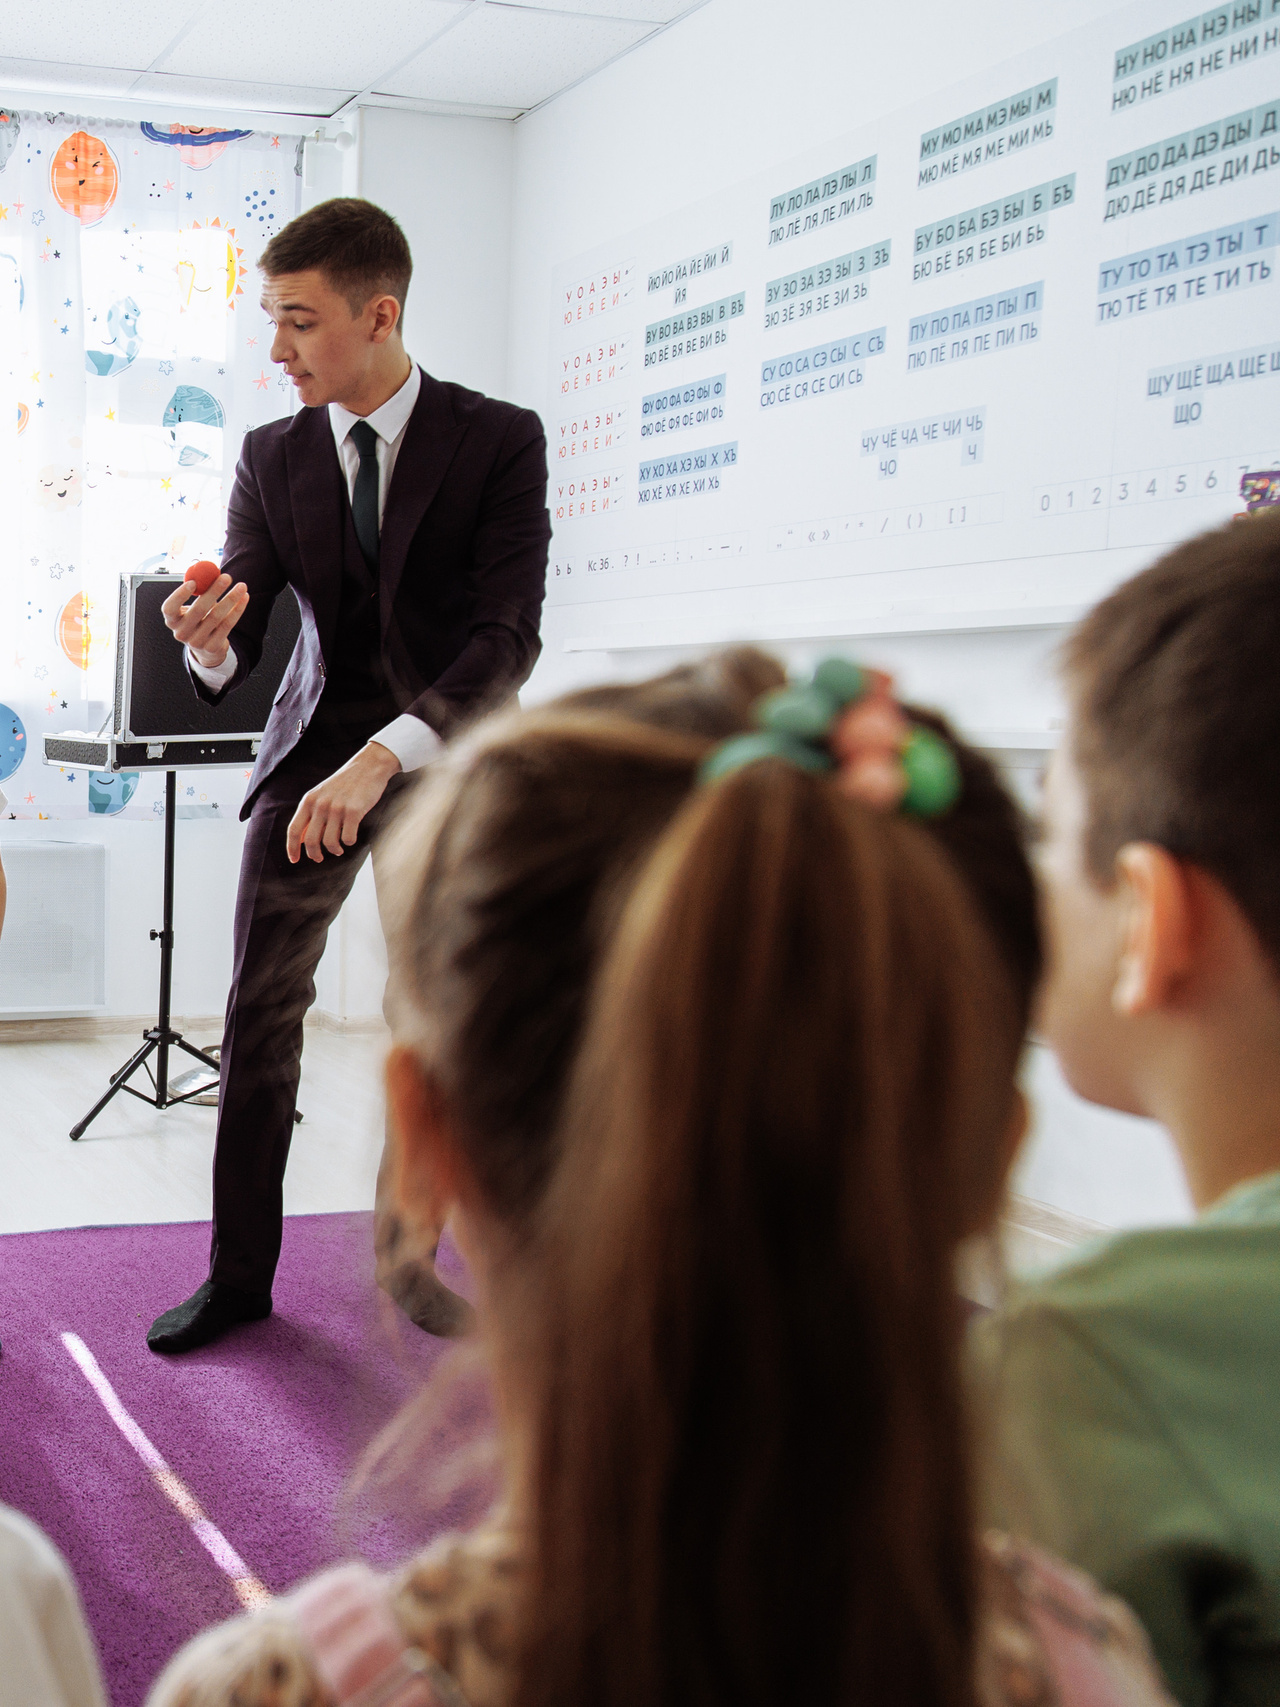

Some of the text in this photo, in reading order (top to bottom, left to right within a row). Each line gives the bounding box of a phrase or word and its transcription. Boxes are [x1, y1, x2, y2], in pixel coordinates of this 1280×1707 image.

[1116, 0, 1261, 77] НУ НО НА НЭ НЫ
[1112, 36, 1258, 111] НЮ НЁ НЯ НЕ НИ
[921, 89, 1051, 157] МУ МО МА МЭ МЫ М
[918, 120, 1053, 186] МЮ МЁ МЯ МЕ МИ МЬ
[1106, 111, 1276, 190] ДУ ДО ДА ДЭ ДЫ Д
[771, 164, 871, 219] ЛУ ЛО ЛА ЛЭ ЛЫ Л
[1104, 195, 1129, 222] ДЮ
[1132, 182, 1156, 212] ДЁ
[1160, 176, 1185, 204] ДЯ
[1190, 166, 1216, 194] ДЕ
[1220, 155, 1248, 184] ДИ
[916, 184, 1072, 251] БУ БО БА БЭ БЫ Б БЪ
[767, 248, 889, 302] ЗУ ЗО ЗА ЗЭ ЗЫ З ЗЪ
[914, 224, 1044, 280] БЮ БЁ БЯ БЕ БИ БЬ
[1102, 225, 1268, 288] ТУ ТО ТА ТЭ ТЫ Т
[564, 292, 619, 325] Ю Ё Я Е И
[566, 271, 620, 303] У О А Э Ы
[1098, 261, 1271, 320] ТЮ ТЁ ТЯ ТЕ ТИ ТЬ
[646, 299, 744, 344] ВУ ВО ВА ВЭ ВЫ В ВЪ
[911, 291, 1036, 341] ПУ ПО ПА ПЭ ПЫ П
[763, 336, 883, 381] СУ СО СА СЭ СЫ С СЪ
[908, 322, 1037, 370] ПЮ ПЁ ПЯ ПЕ ПИ ПЬ
[1148, 354, 1266, 396] ЩУ ЩЁ ЩА ЩЕ
[862, 415, 982, 452] ЧУ ЧЁ ЧА ЧЕ ЧИ ЧЬ
[1174, 402, 1202, 424] ЩО
[880, 444, 977, 476] ЧО Ч
[1041, 471, 1217, 511] 0 1 2 3 4 5 6
